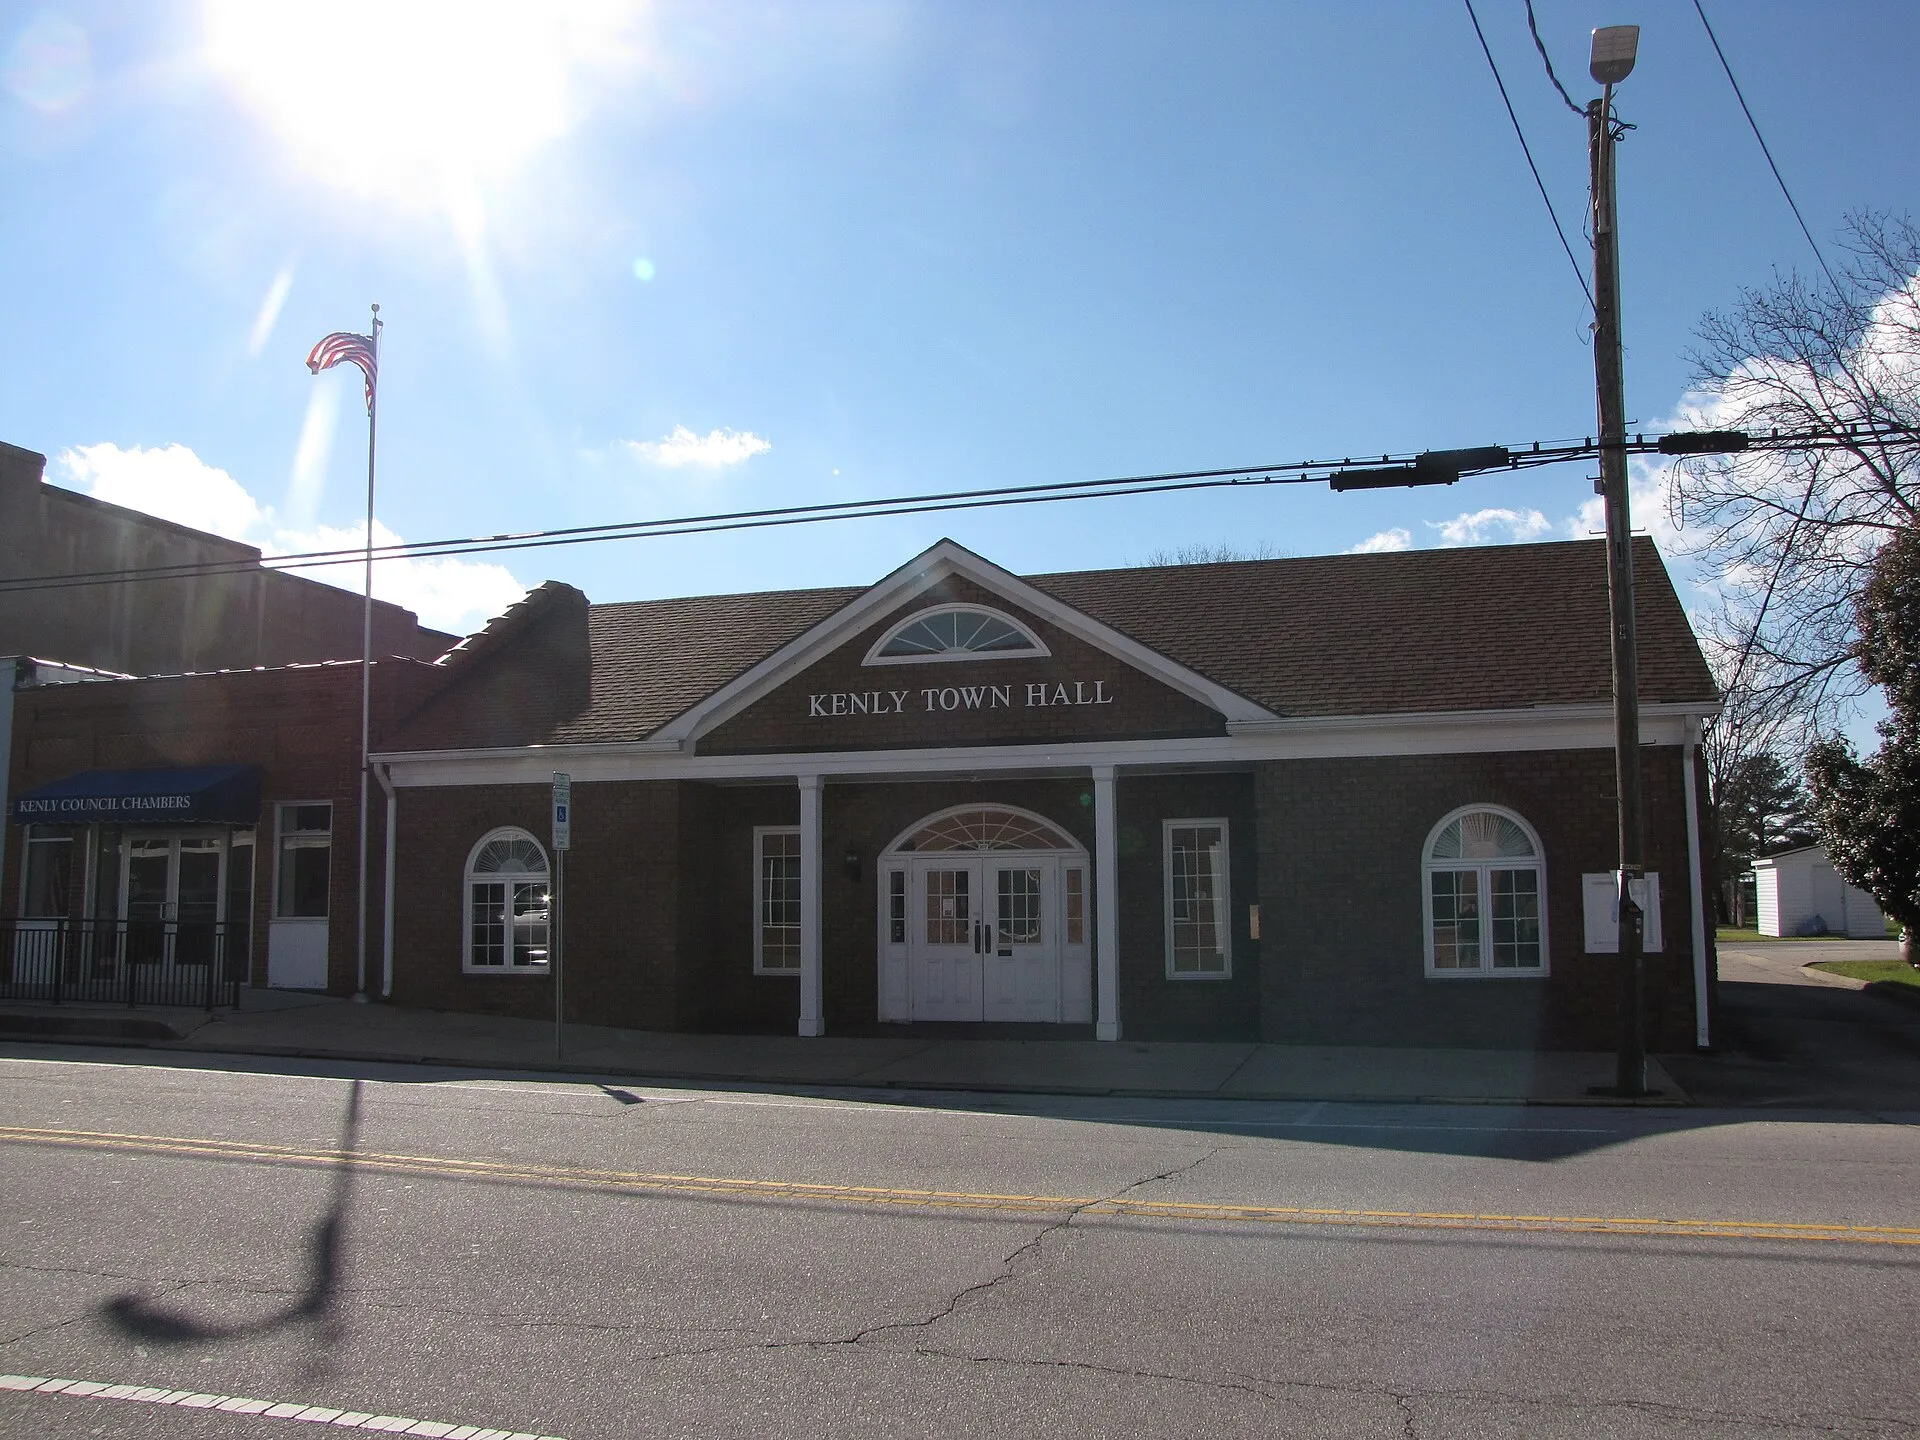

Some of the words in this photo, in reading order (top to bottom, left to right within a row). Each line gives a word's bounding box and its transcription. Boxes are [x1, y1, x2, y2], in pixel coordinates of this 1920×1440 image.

[808, 690, 910, 717] KENLY
[921, 684, 1012, 712] TOWN
[1024, 680, 1114, 707] HALL
[19, 799, 59, 813] KENLY
[61, 797, 120, 811] COUNCIL
[121, 795, 191, 810] CHAMBERS
